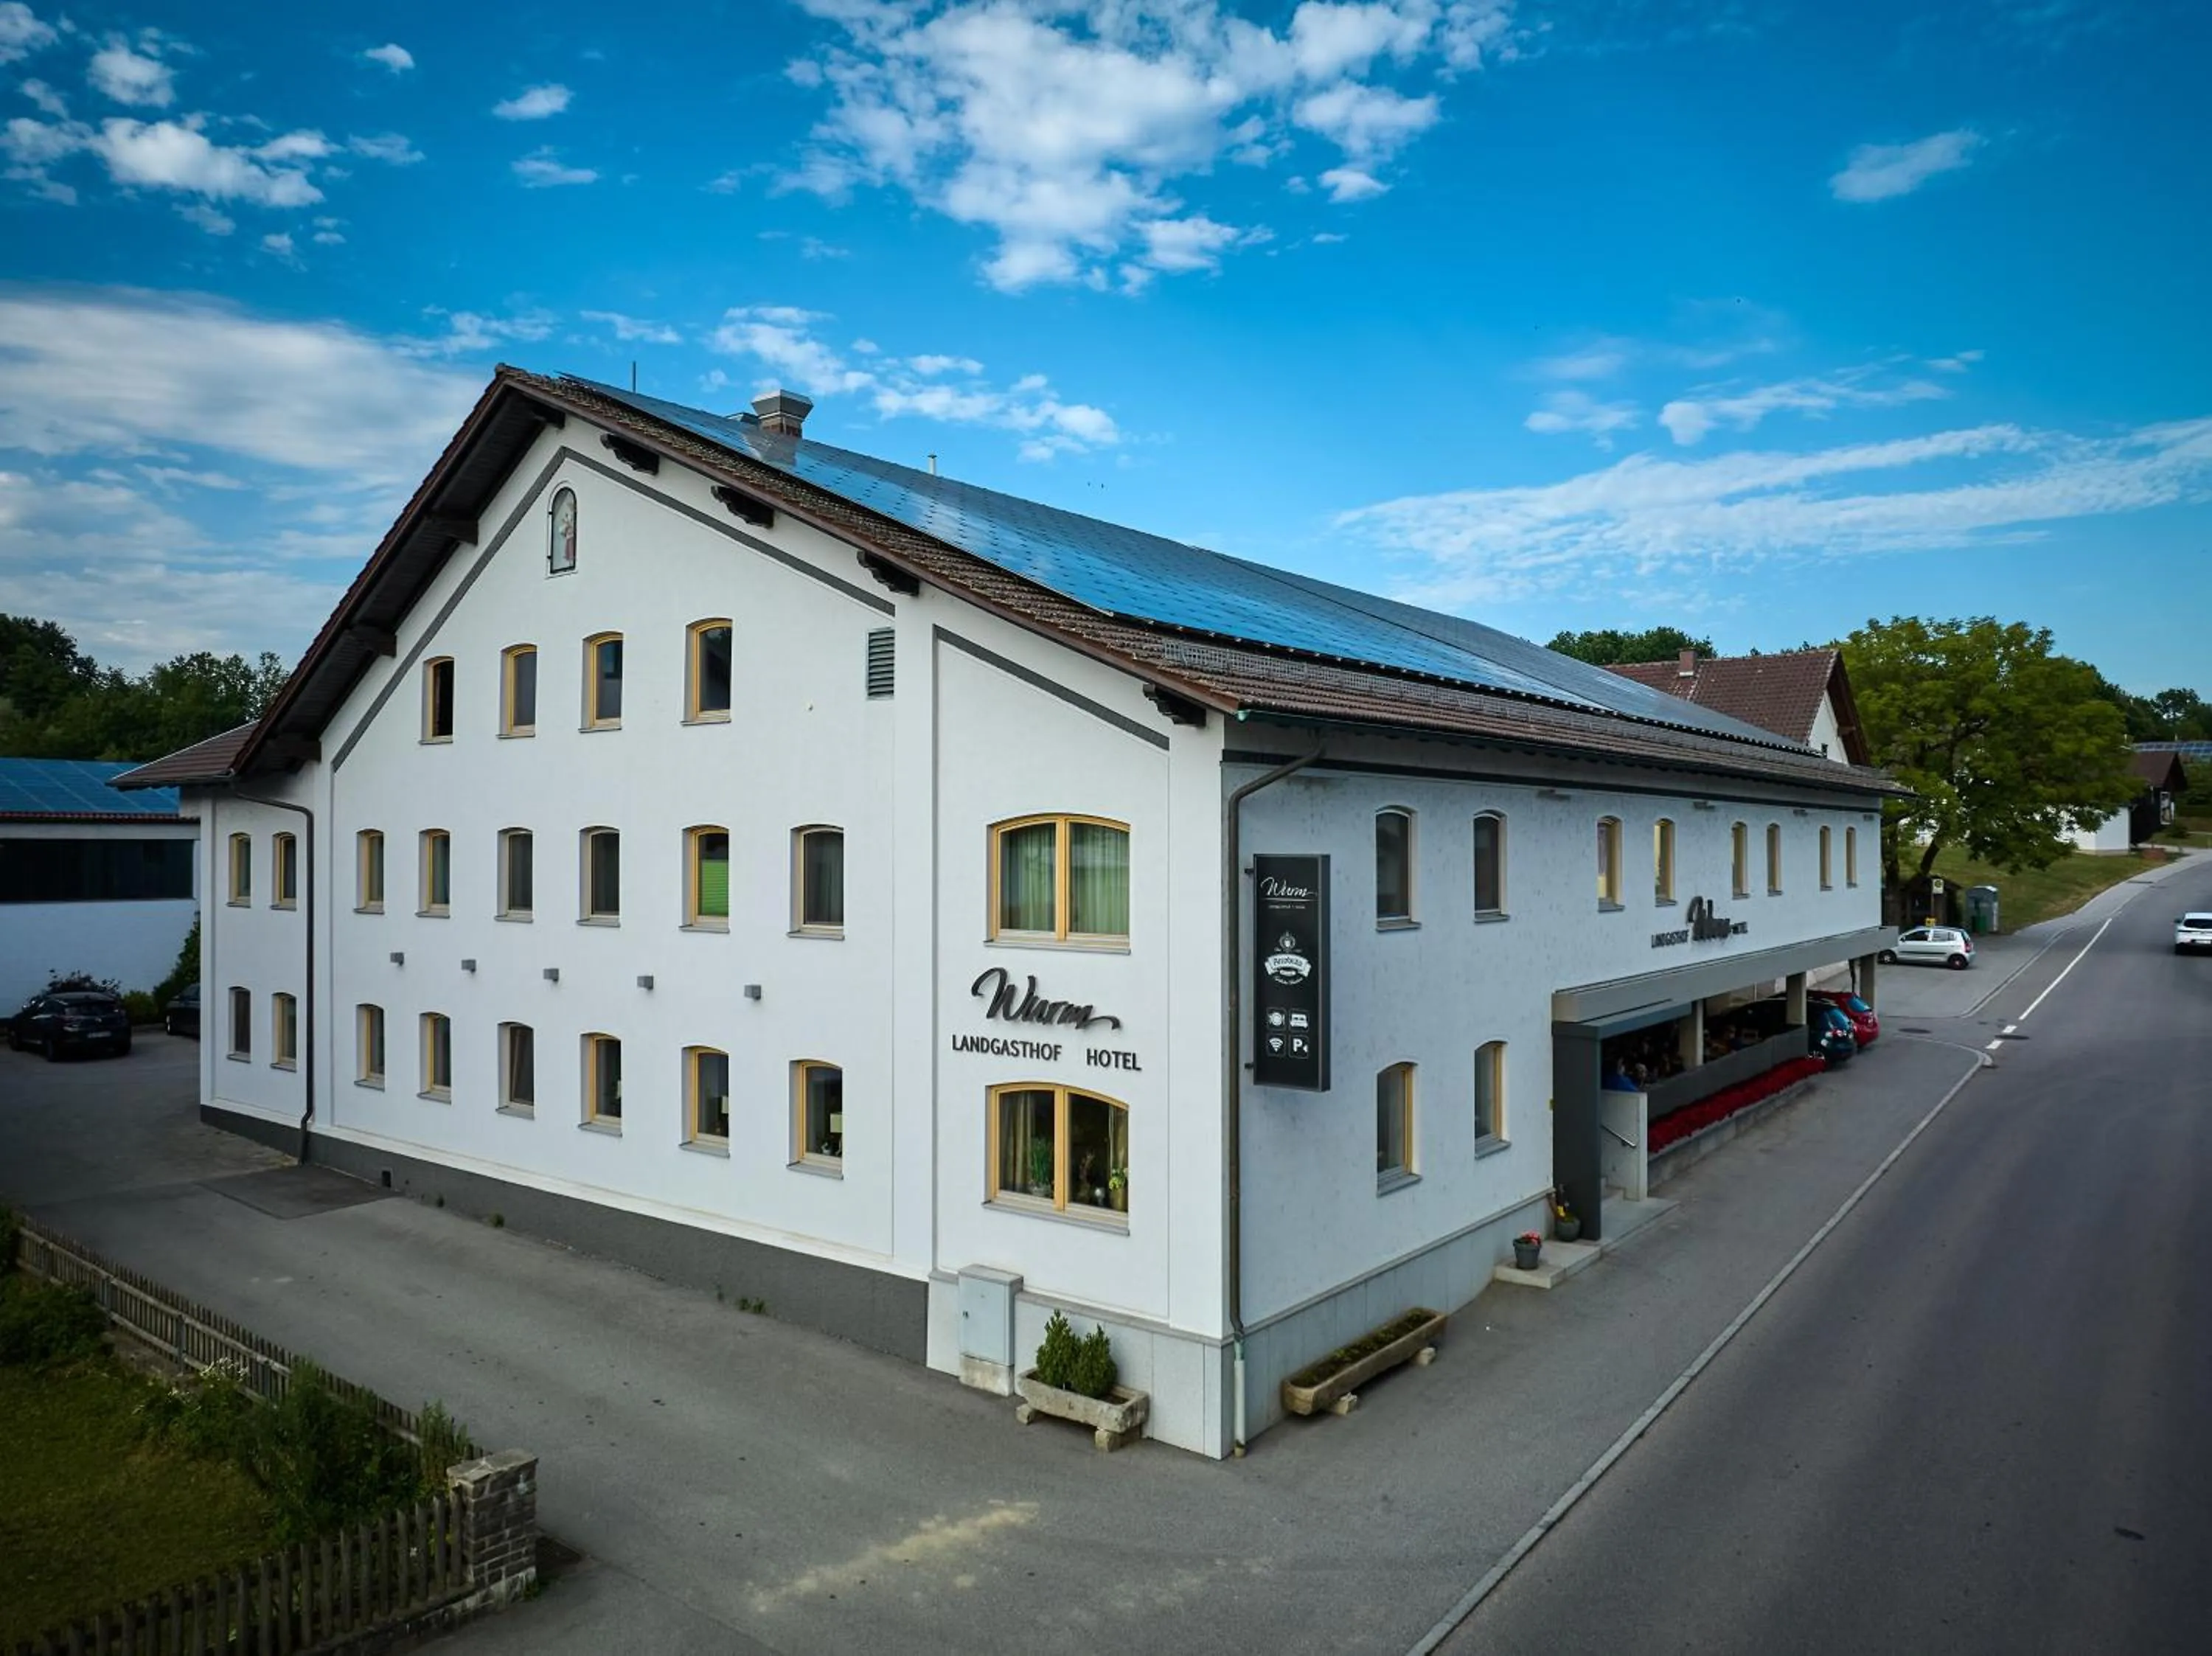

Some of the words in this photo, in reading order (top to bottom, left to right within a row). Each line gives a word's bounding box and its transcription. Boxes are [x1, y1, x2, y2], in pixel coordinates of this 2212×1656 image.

[1260, 877, 1318, 897] Wurm
[971, 967, 1121, 1030] Wurm
[952, 1034, 1062, 1062] LANDGASTHOF
[1086, 1048, 1142, 1071] HOTEL
[1293, 1038, 1303, 1052] P
